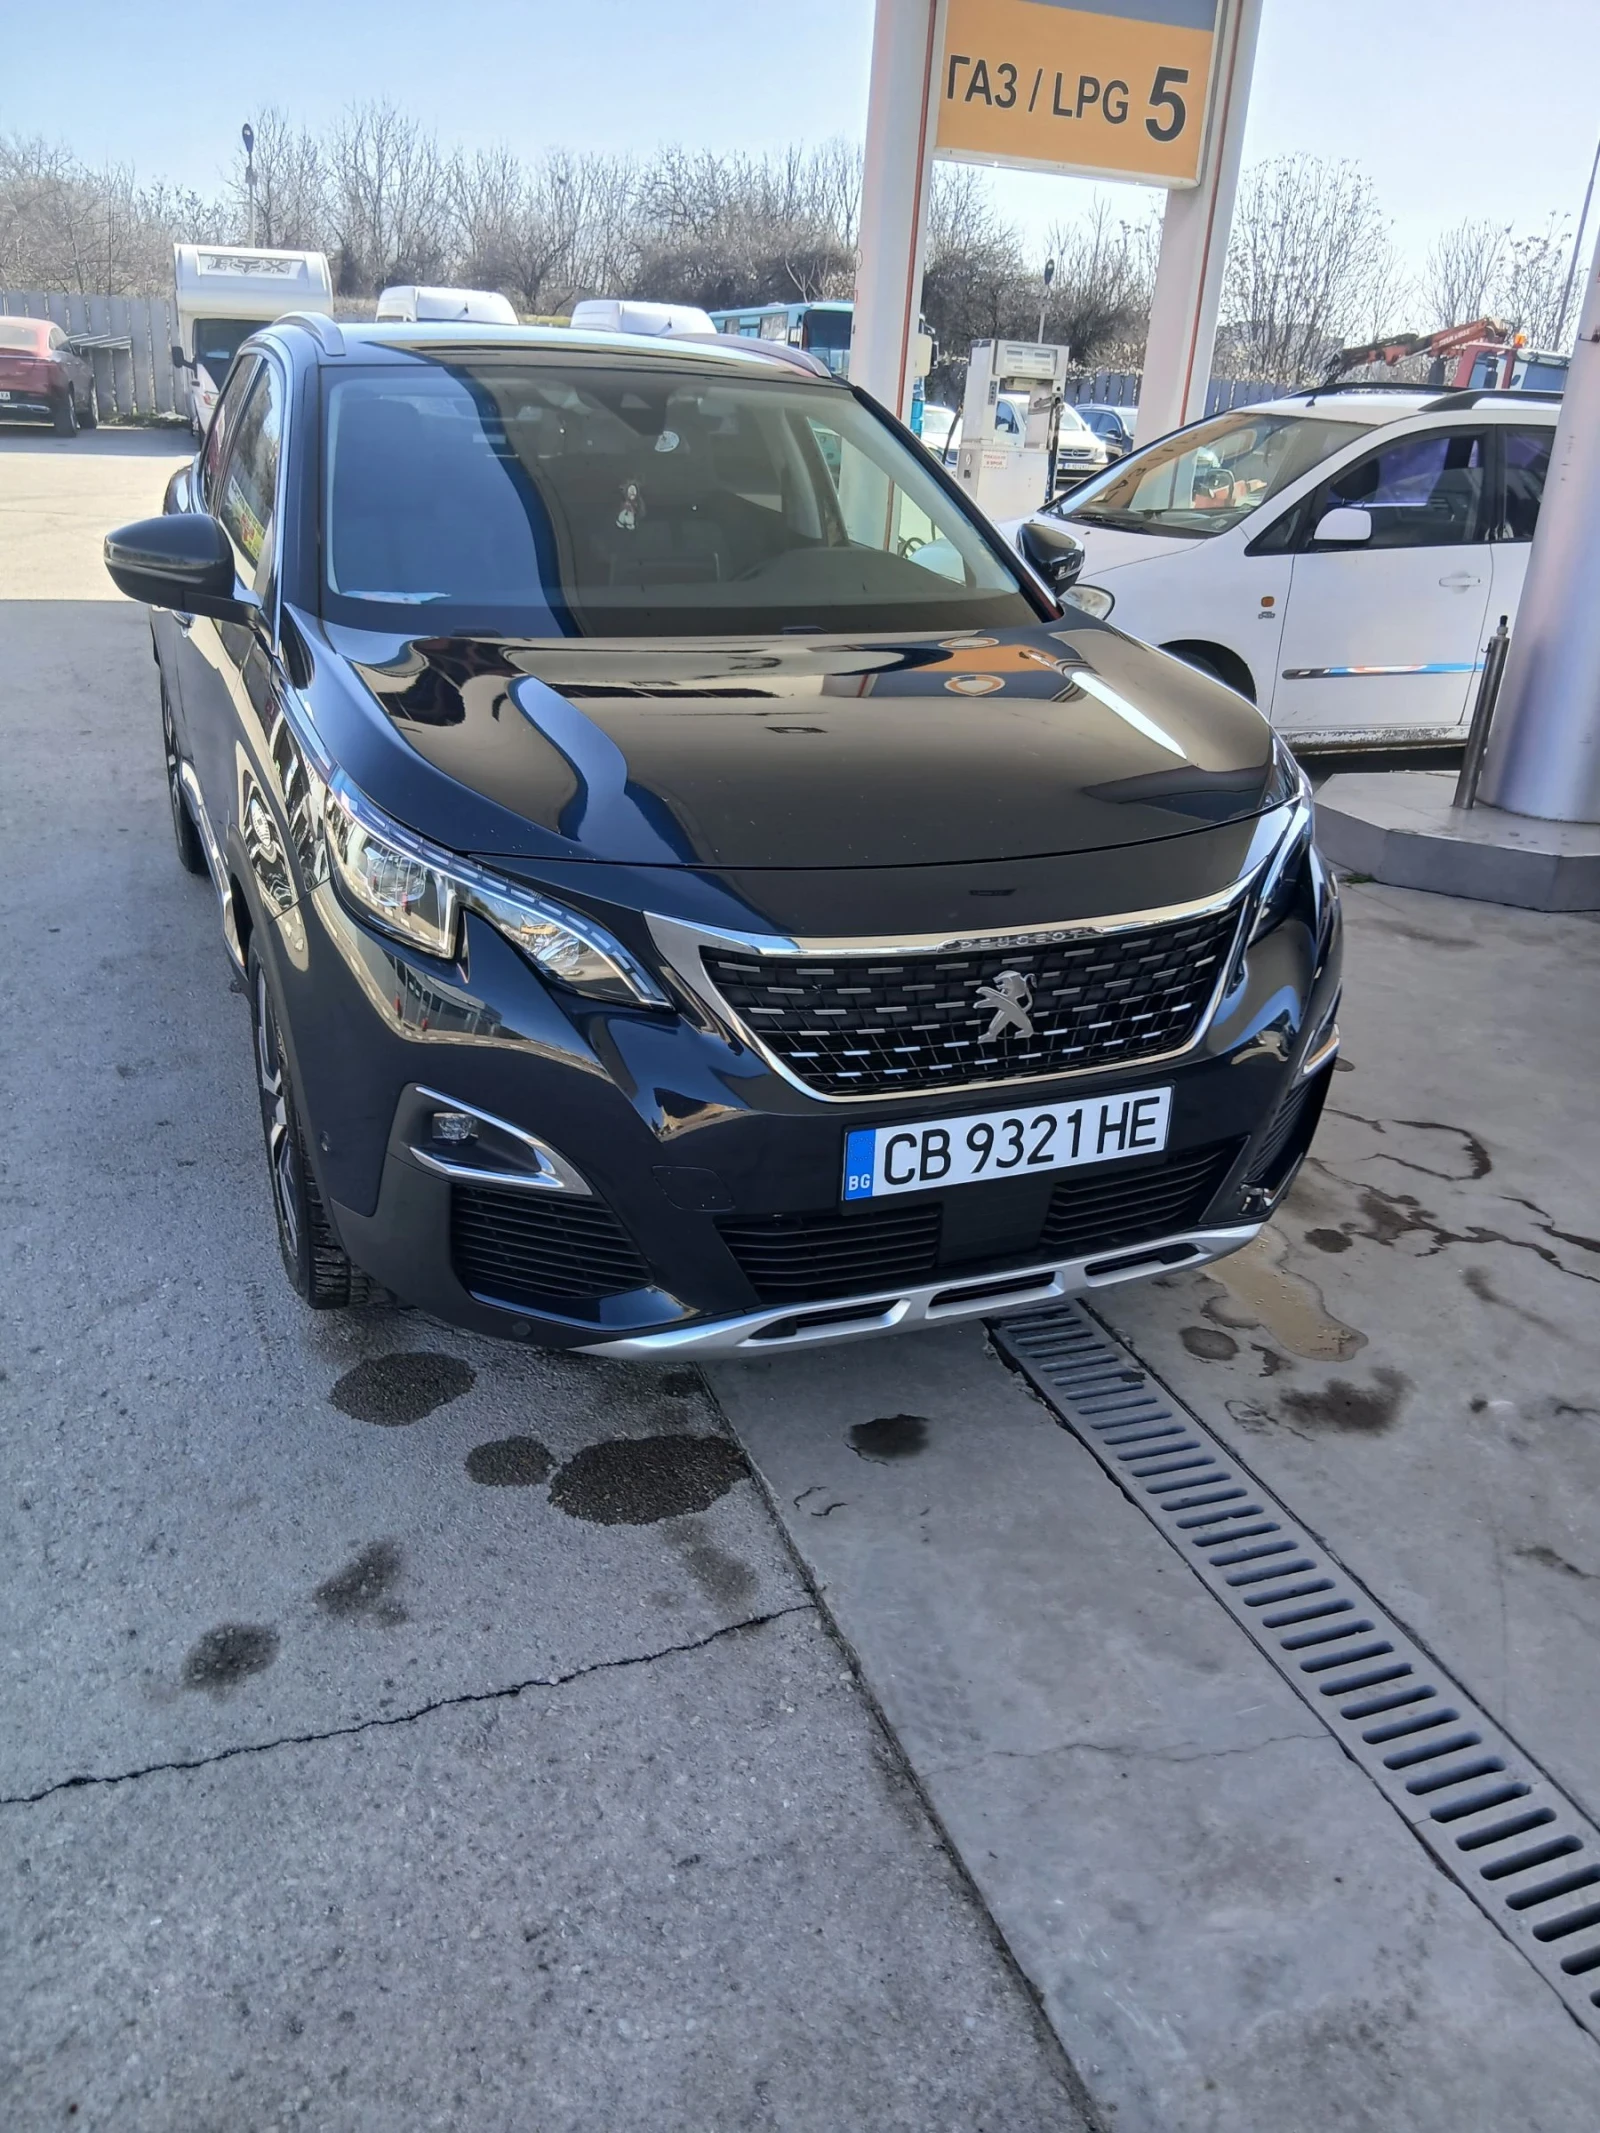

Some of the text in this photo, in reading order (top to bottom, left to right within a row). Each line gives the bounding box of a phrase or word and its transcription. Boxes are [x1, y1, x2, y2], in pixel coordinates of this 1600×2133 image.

[946, 55, 1018, 109] ГАЗ
[1053, 71, 1129, 124] LPG
[1145, 66, 1190, 142] 5
[960, 928, 1083, 949] PEUGEOT
[884, 1096, 1160, 1185] CB 9321 HE
[848, 1174, 871, 1191] BG
